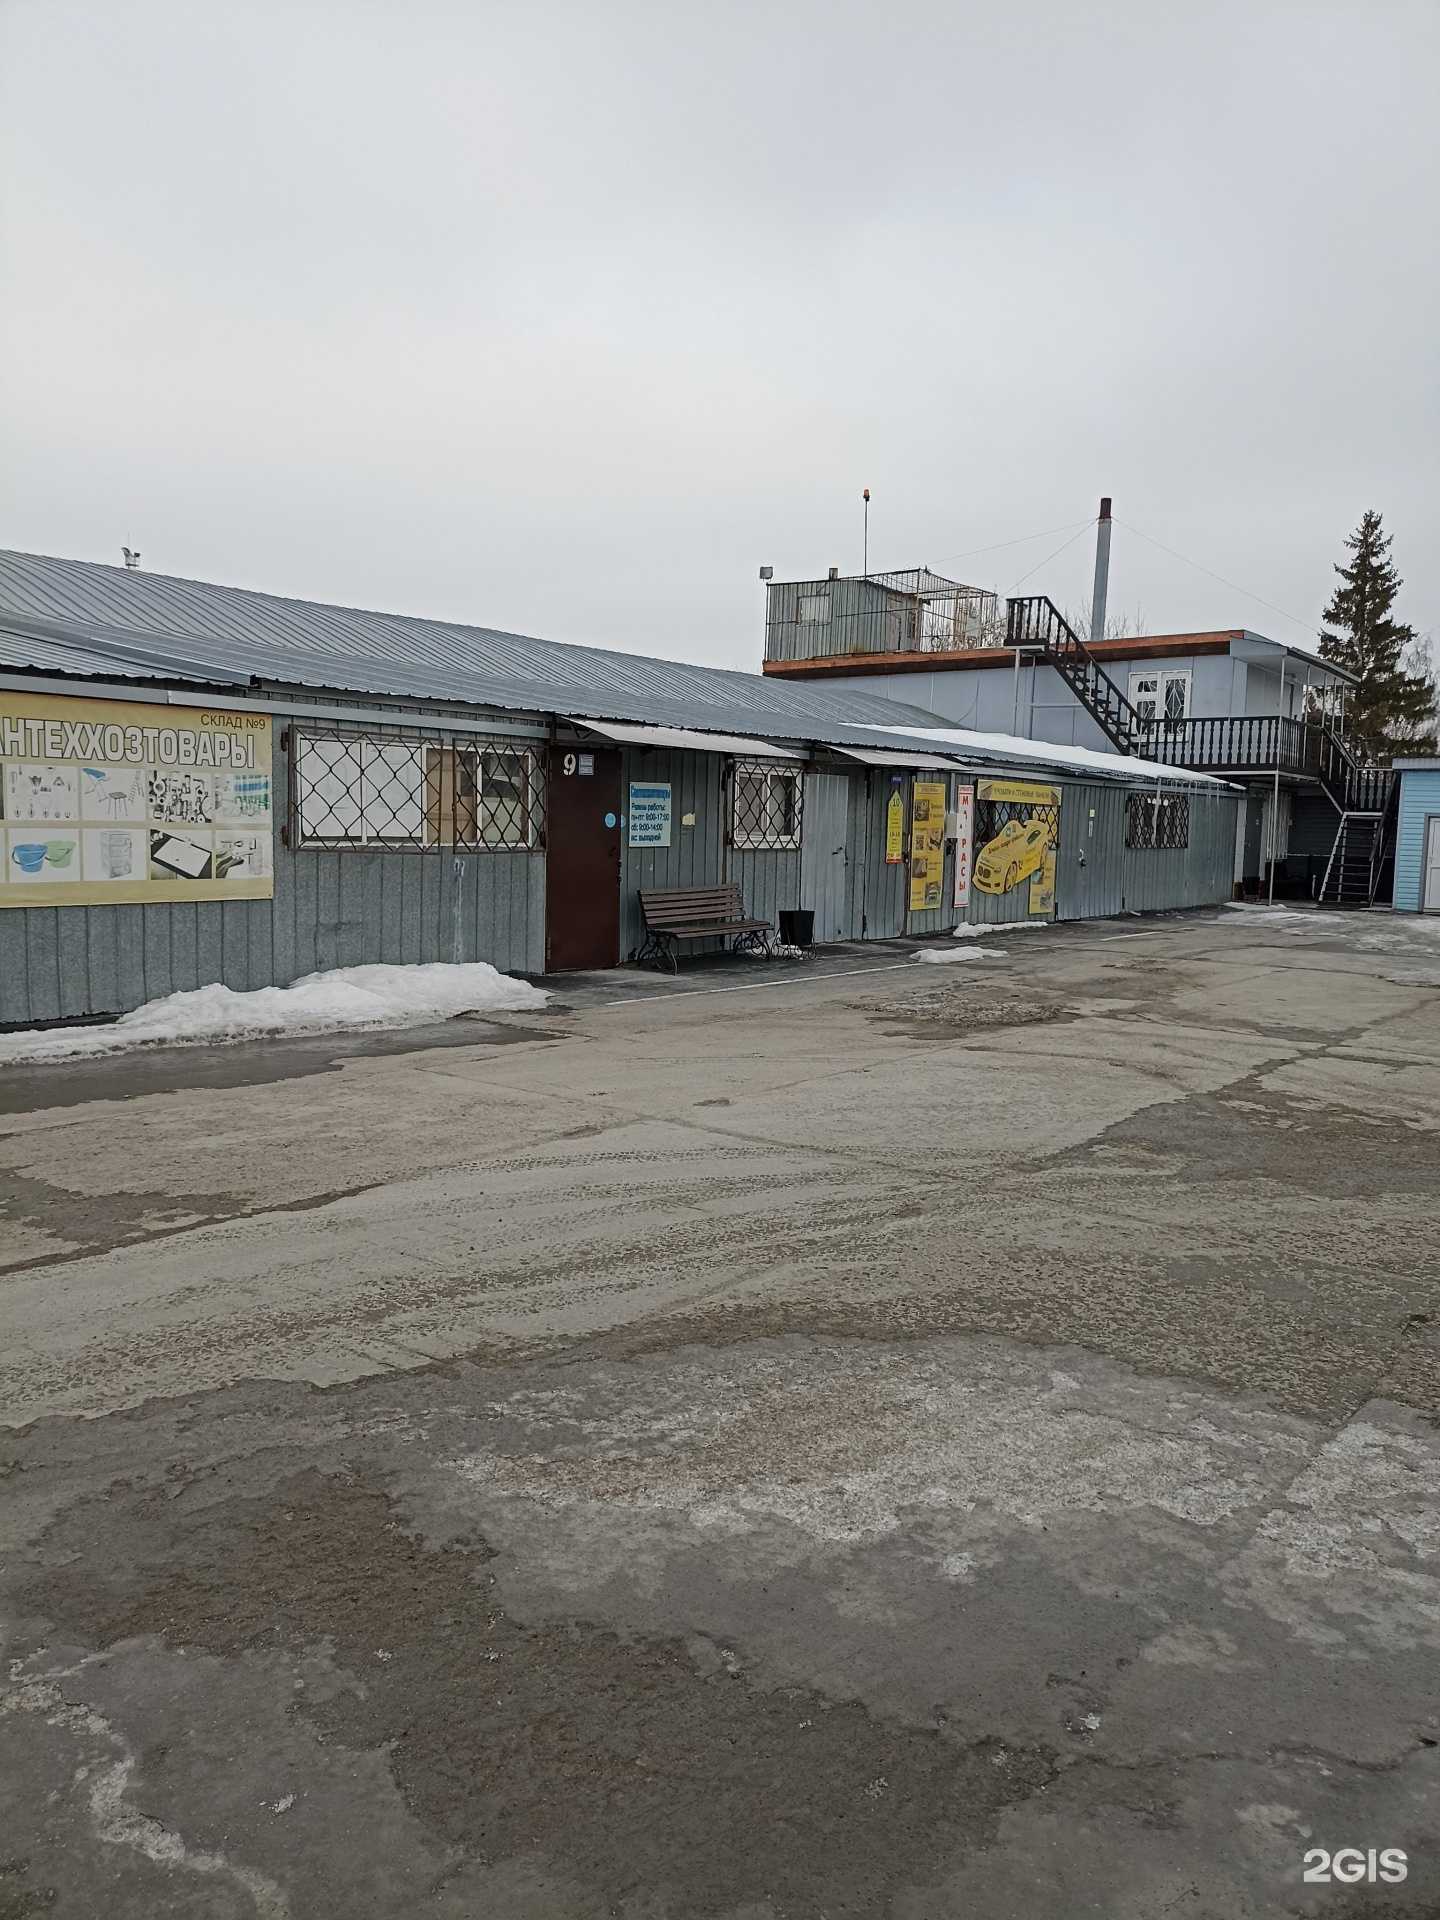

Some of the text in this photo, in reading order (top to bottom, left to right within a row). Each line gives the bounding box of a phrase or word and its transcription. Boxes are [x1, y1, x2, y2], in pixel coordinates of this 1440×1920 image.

[200, 713, 266, 731] СКЛАД №9
[0, 716, 255, 769] НТЕХХОЗТОВАРЫ
[563, 753, 577, 776] 9
